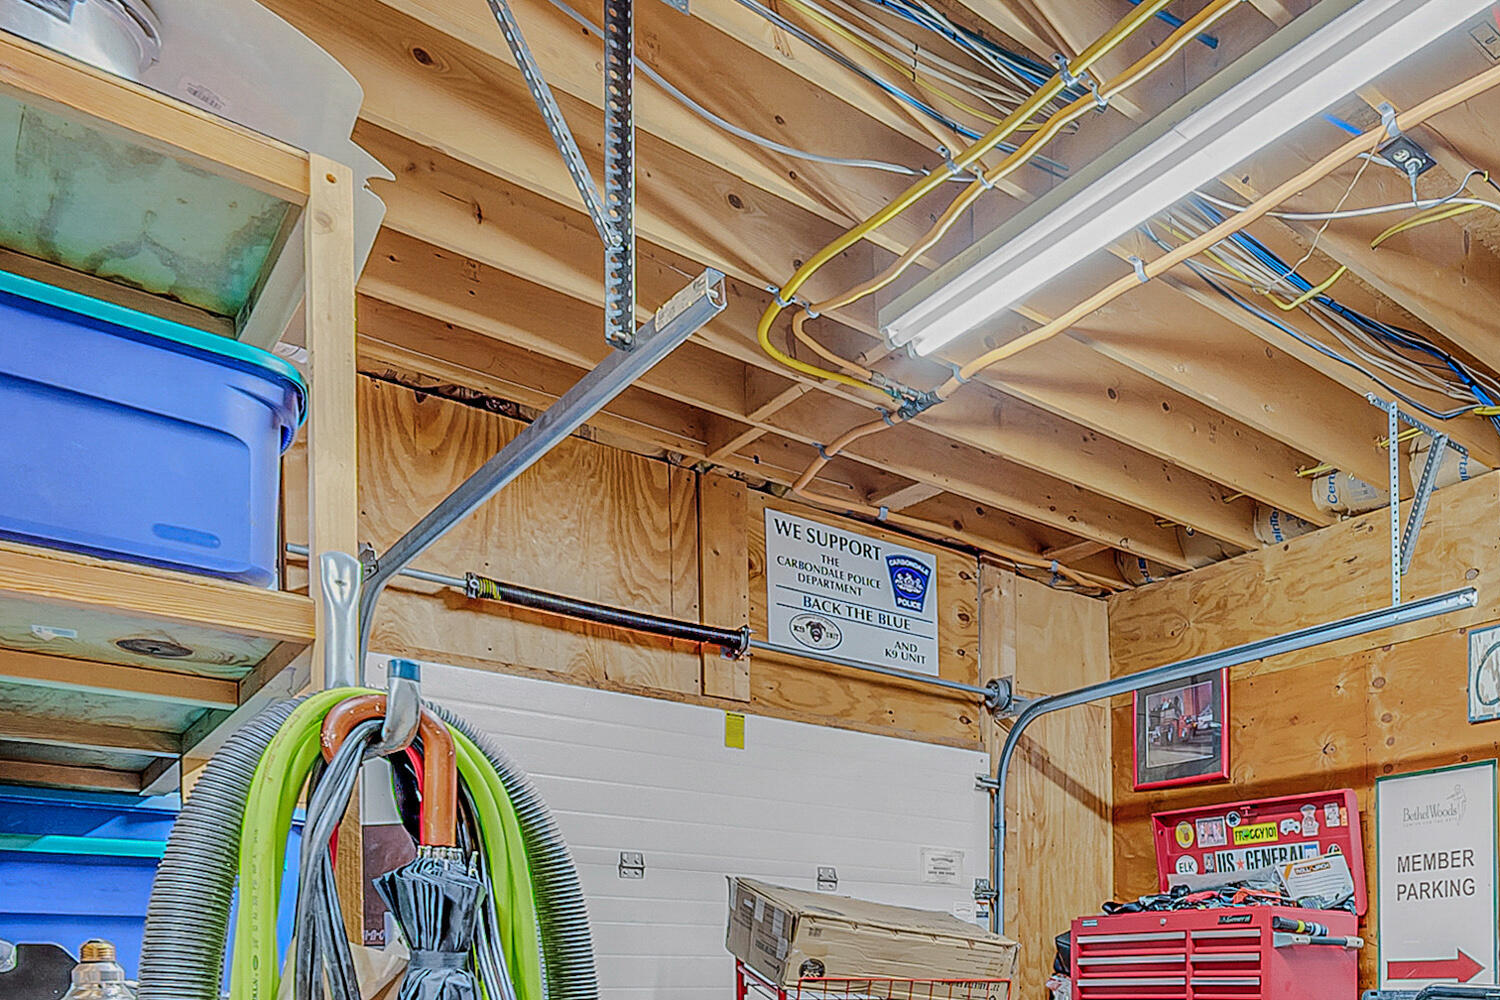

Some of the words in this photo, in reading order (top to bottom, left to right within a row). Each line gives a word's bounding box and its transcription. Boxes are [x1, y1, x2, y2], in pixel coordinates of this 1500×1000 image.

[774, 518, 802, 540] WE
[807, 528, 881, 561] SUPPORT
[820, 554, 840, 567] THE
[776, 556, 845, 580] CARBONDALE
[847, 573, 881, 589] POLICE
[797, 573, 862, 596] DEPARTMENT
[803, 595, 841, 615] BACK
[846, 605, 873, 622] THE
[878, 613, 911, 630] BLUE
[897, 598, 922, 610] POLICE
[885, 648, 899, 659] K9
[901, 652, 926, 665] UNIT
[894, 641, 918, 653] AND
[1178, 861, 1195, 873] ELK
[1245, 845, 1304, 870] GENERAL
[1397, 849, 1475, 873] MEMBER
[1397, 878, 1476, 901] PARKING
